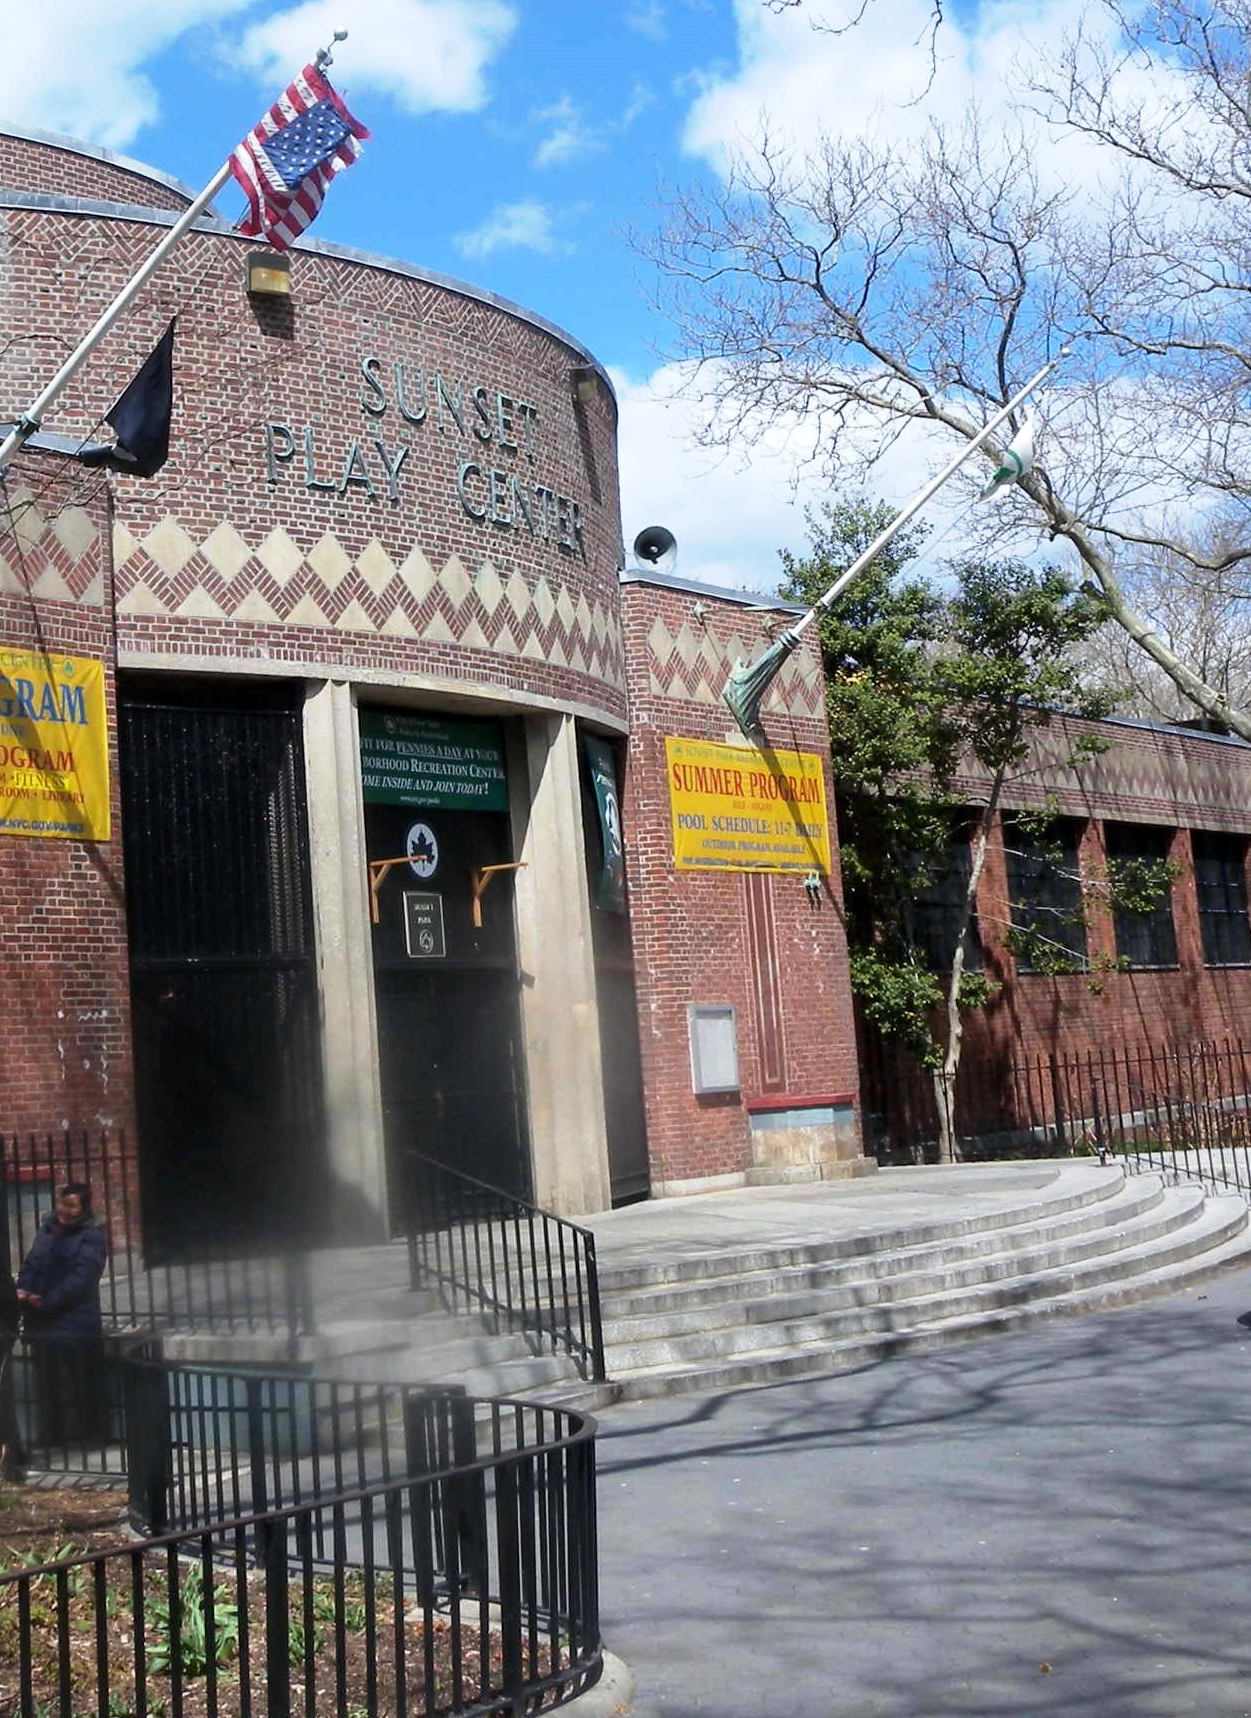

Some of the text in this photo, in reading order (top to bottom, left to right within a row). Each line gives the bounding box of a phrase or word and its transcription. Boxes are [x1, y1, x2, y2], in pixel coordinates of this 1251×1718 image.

[360, 357, 537, 457] SUNSET
[265, 422, 584, 551] PLAY CENTER
[410, 758, 468, 776] RECREATION
[14, 773, 65, 788] FITNESS
[382, 776, 413, 790] INSIDE
[413, 779, 434, 791] AND
[433, 780, 457, 793] JOIN
[672, 762, 822, 804] SUMMER PROGRAM
[677, 812, 708, 830] POOL
